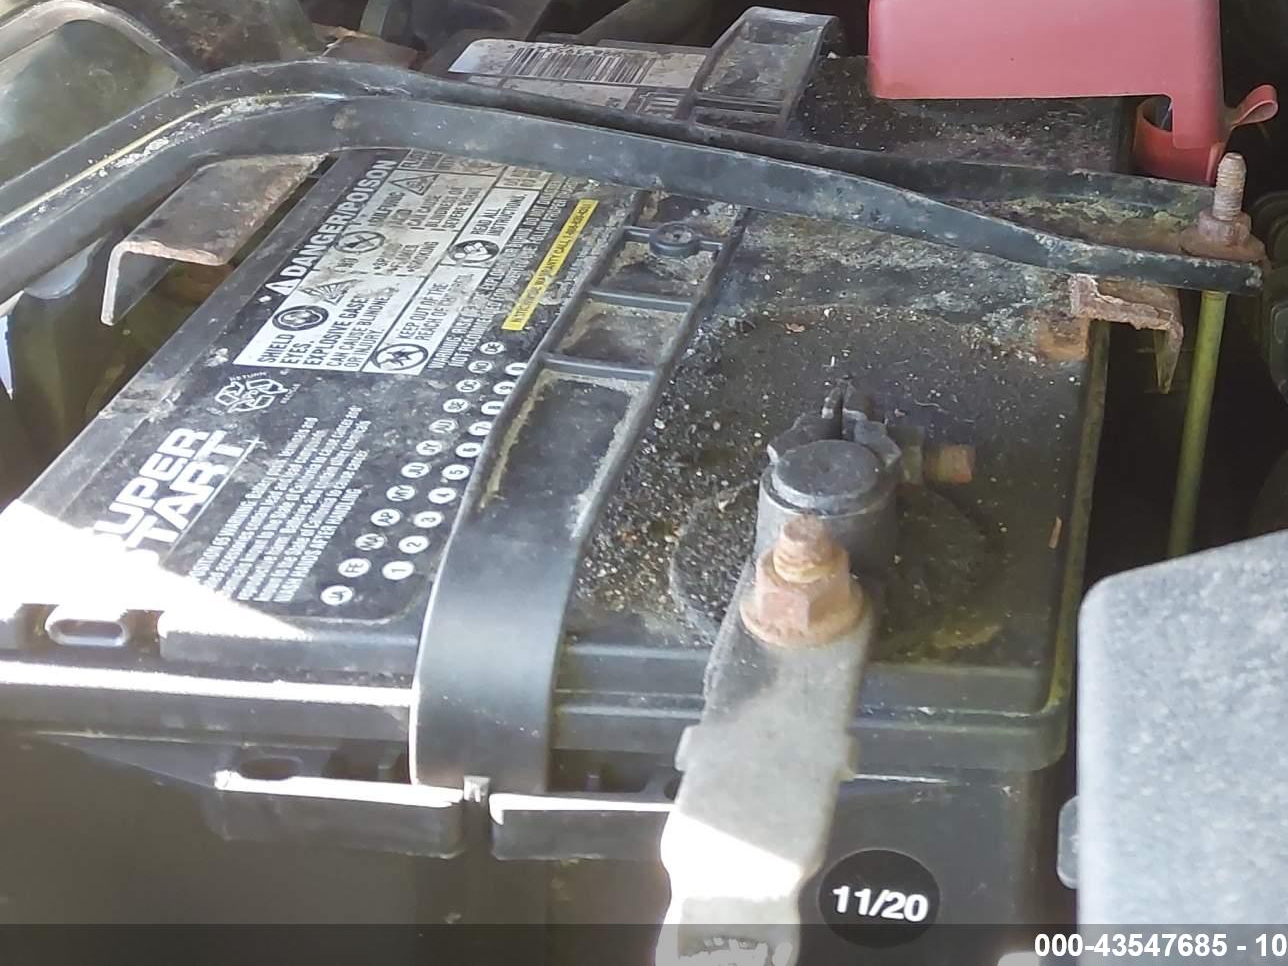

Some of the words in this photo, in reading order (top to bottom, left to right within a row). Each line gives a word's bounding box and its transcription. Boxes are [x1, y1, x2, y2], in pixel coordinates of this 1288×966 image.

[283, 161, 393, 276] DANGER/POISON
[470, 219, 492, 234] READ
[481, 208, 501, 219] ALL
[397, 322, 419, 339] KEEP
[409, 306, 431, 320] OUT
[420, 296, 438, 306] OF
[415, 318, 442, 340] REACH
[258, 334, 294, 362] SHIELD
[280, 341, 313, 364] EYES.
[304, 321, 351, 365] EXPLOSIVE
[326, 352, 348, 366] CAN
[339, 328, 367, 350] CAUSE
[343, 356, 363, 367] OR
[354, 329, 383, 355] INJURY.
[448, 352, 469, 367] NOT
[93, 428, 210, 535] UPER
[125, 430, 245, 548] TART
[274, 578, 302, 601] WASH
[291, 550, 321, 577] HANDS
[310, 525, 336, 549] AFTER
[832, 885, 929, 922] 11/20
